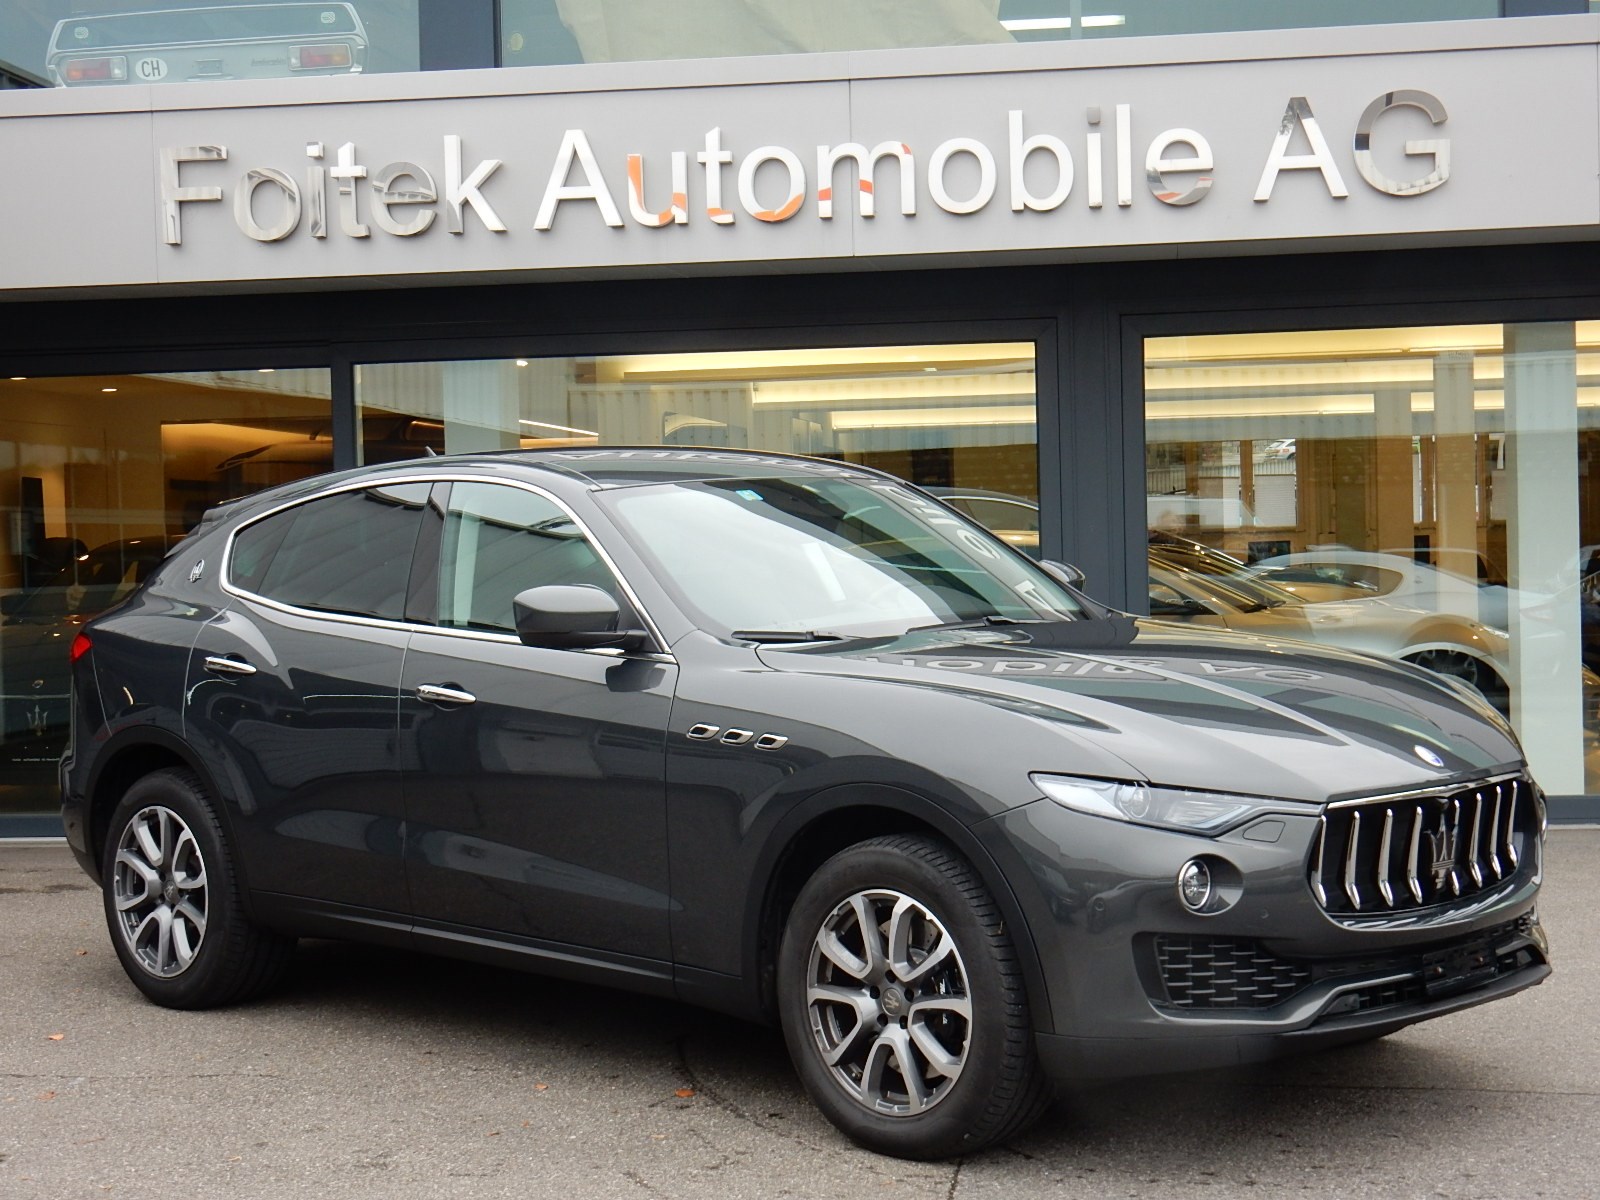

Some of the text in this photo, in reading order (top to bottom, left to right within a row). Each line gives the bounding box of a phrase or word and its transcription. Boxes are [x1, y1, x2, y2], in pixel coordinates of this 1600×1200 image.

[141, 59, 161, 78] CH
[158, 88, 1452, 246] Foitek Automobile AG
